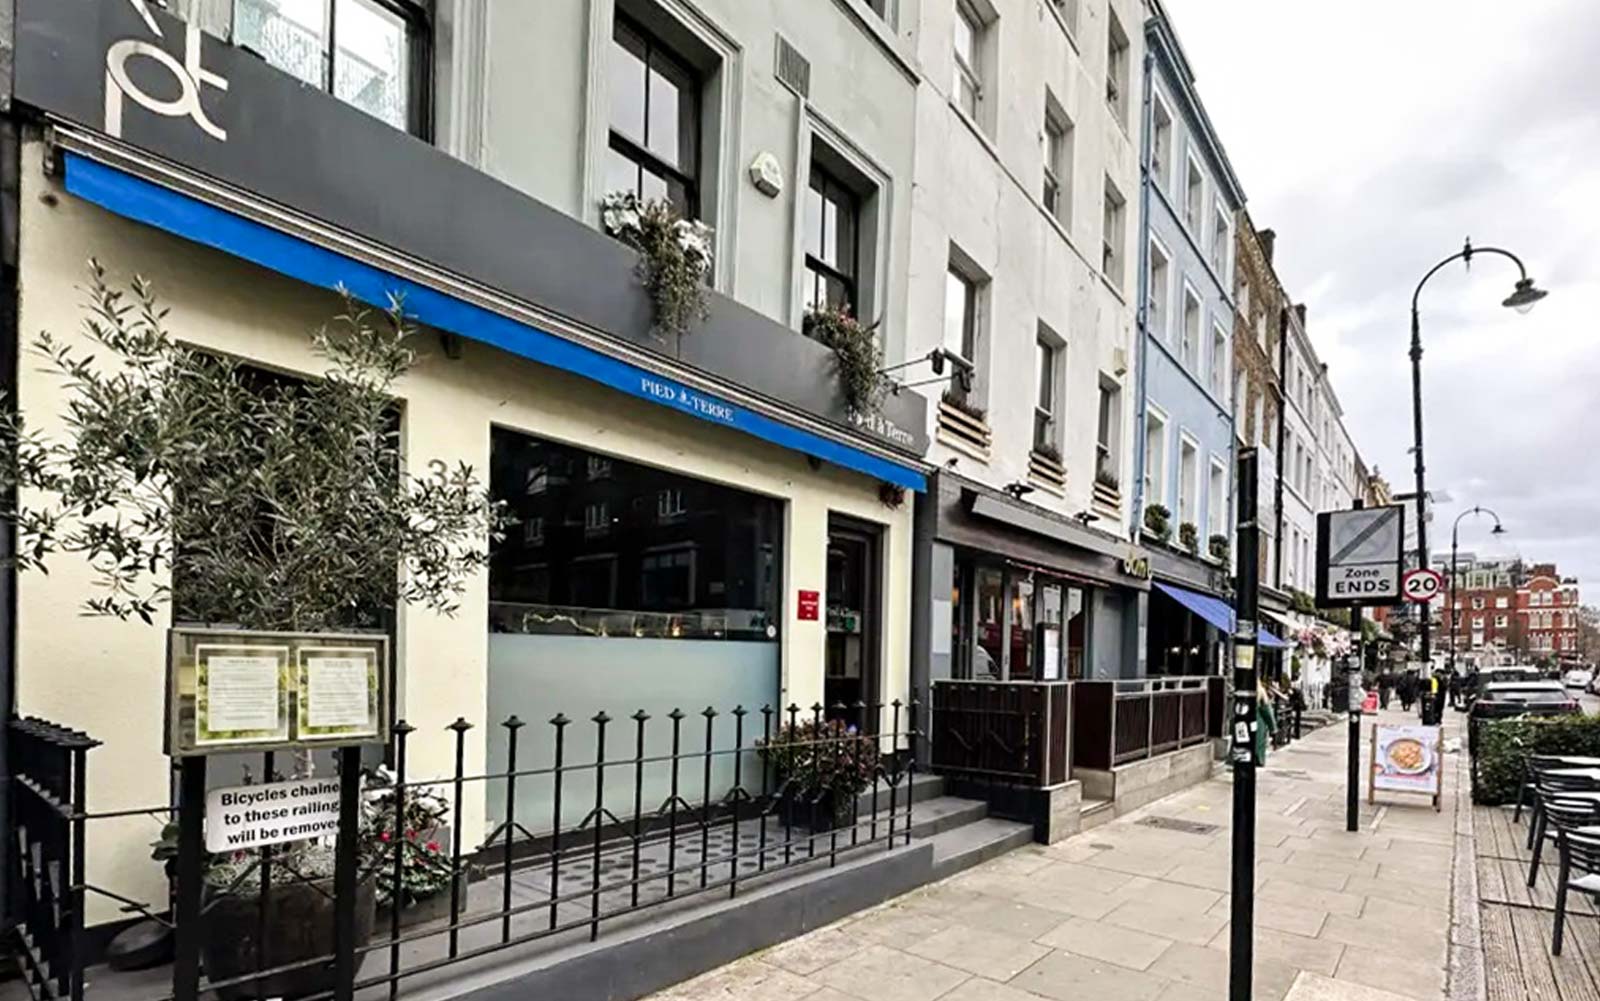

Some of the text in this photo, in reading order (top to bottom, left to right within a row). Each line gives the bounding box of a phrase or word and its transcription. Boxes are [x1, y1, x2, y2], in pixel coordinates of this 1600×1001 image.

[641, 378, 676, 399] PIED
[691, 396, 734, 422] TERRE
[1345, 568, 1380, 578] Zone
[1335, 579, 1390, 593] ENDS
[1408, 577, 1437, 592] 20
[221, 788, 287, 806] Bicycles
[224, 813, 241, 826] to
[244, 807, 288, 823] these
[227, 829, 256, 844] will
[260, 827, 279, 840] be
